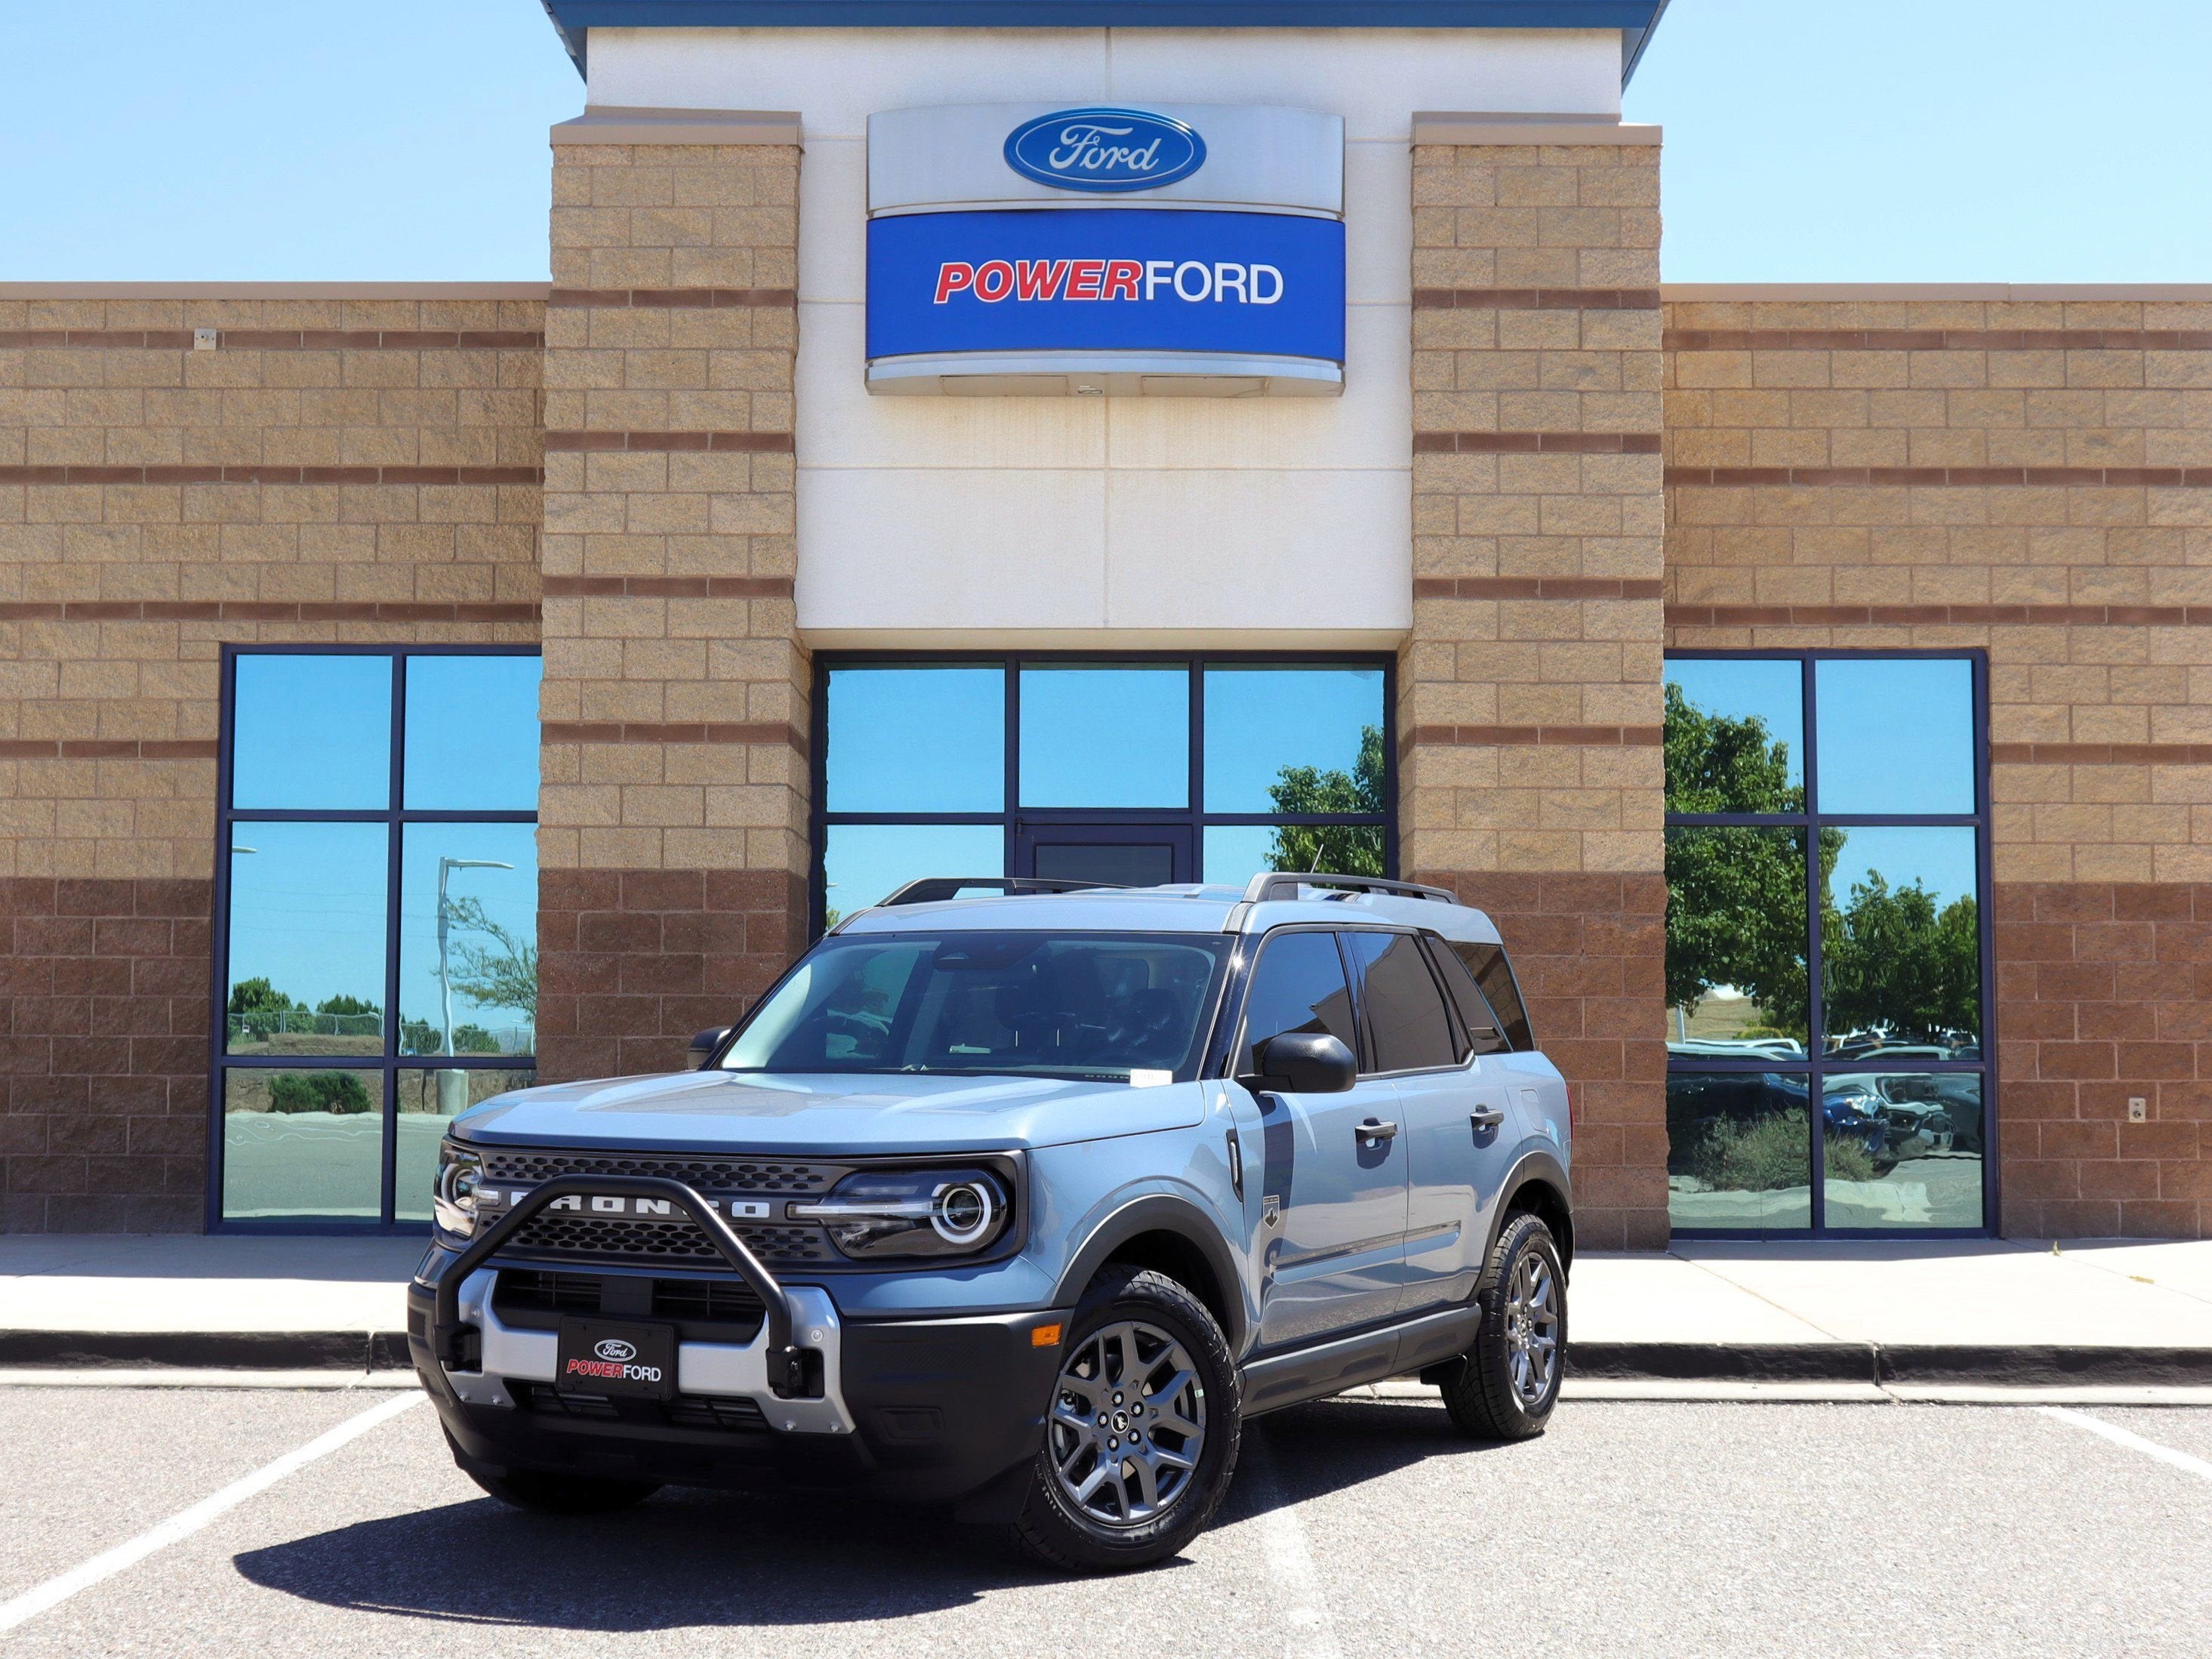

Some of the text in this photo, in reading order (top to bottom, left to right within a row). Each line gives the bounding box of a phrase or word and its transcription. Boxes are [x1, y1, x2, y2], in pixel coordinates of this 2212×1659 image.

[1049, 124, 1163, 171] Ford
[933, 259, 1284, 304] POWERFORD
[510, 1191, 771, 1219] RONO
[602, 1343, 628, 1358] Ford
[566, 1359, 662, 1382] POWERFORD
